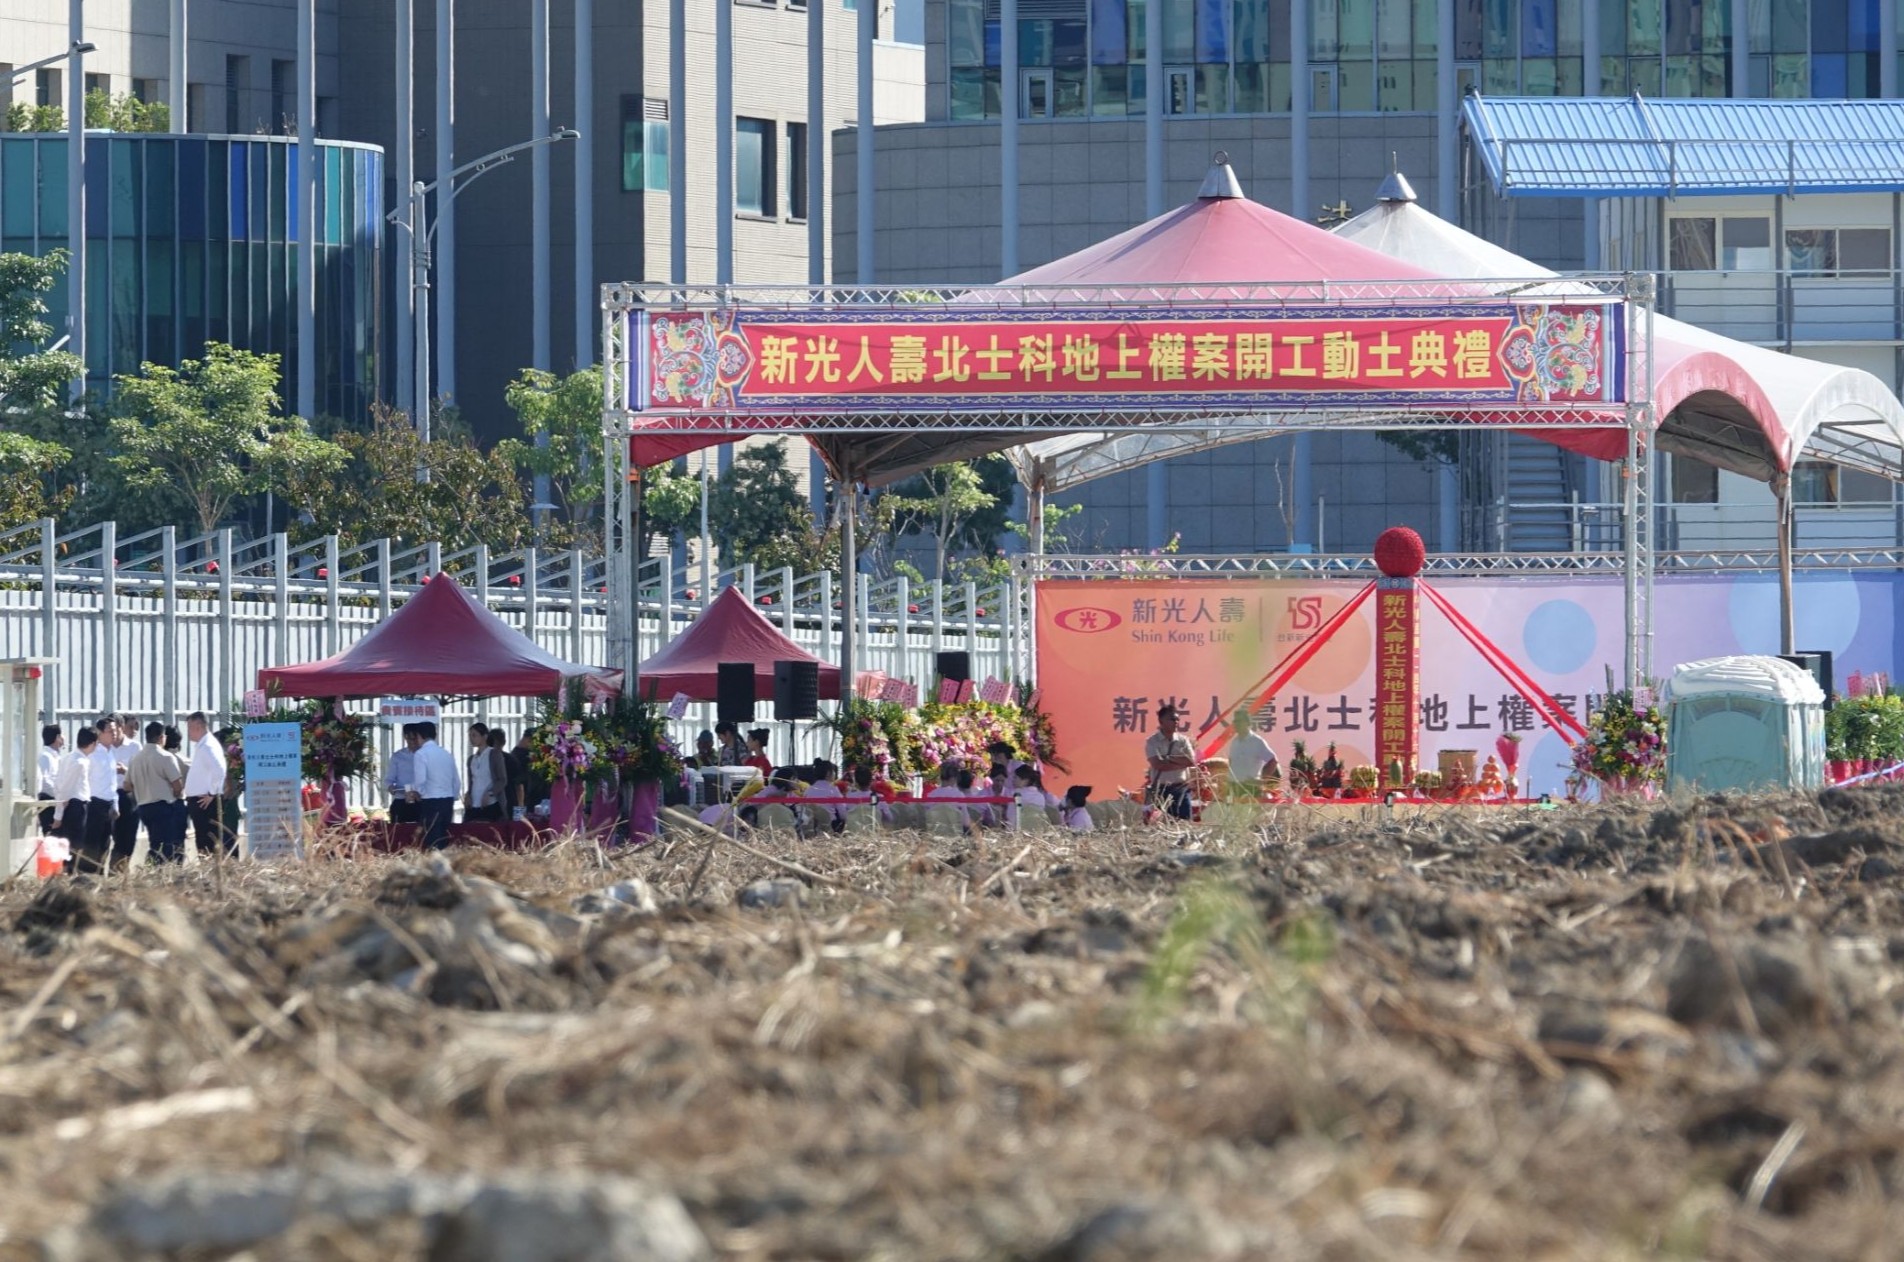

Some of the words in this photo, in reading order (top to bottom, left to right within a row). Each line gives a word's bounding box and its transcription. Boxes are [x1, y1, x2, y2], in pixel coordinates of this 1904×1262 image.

[760, 330, 1492, 385] 新光人壽北士科地上權案開工動土典禮
[1078, 611, 1098, 630] 光
[1132, 598, 1246, 623] 新光人壽
[1132, 629, 1162, 643] Shin
[1168, 629, 1205, 647] Kong
[1210, 629, 1235, 643] Life
